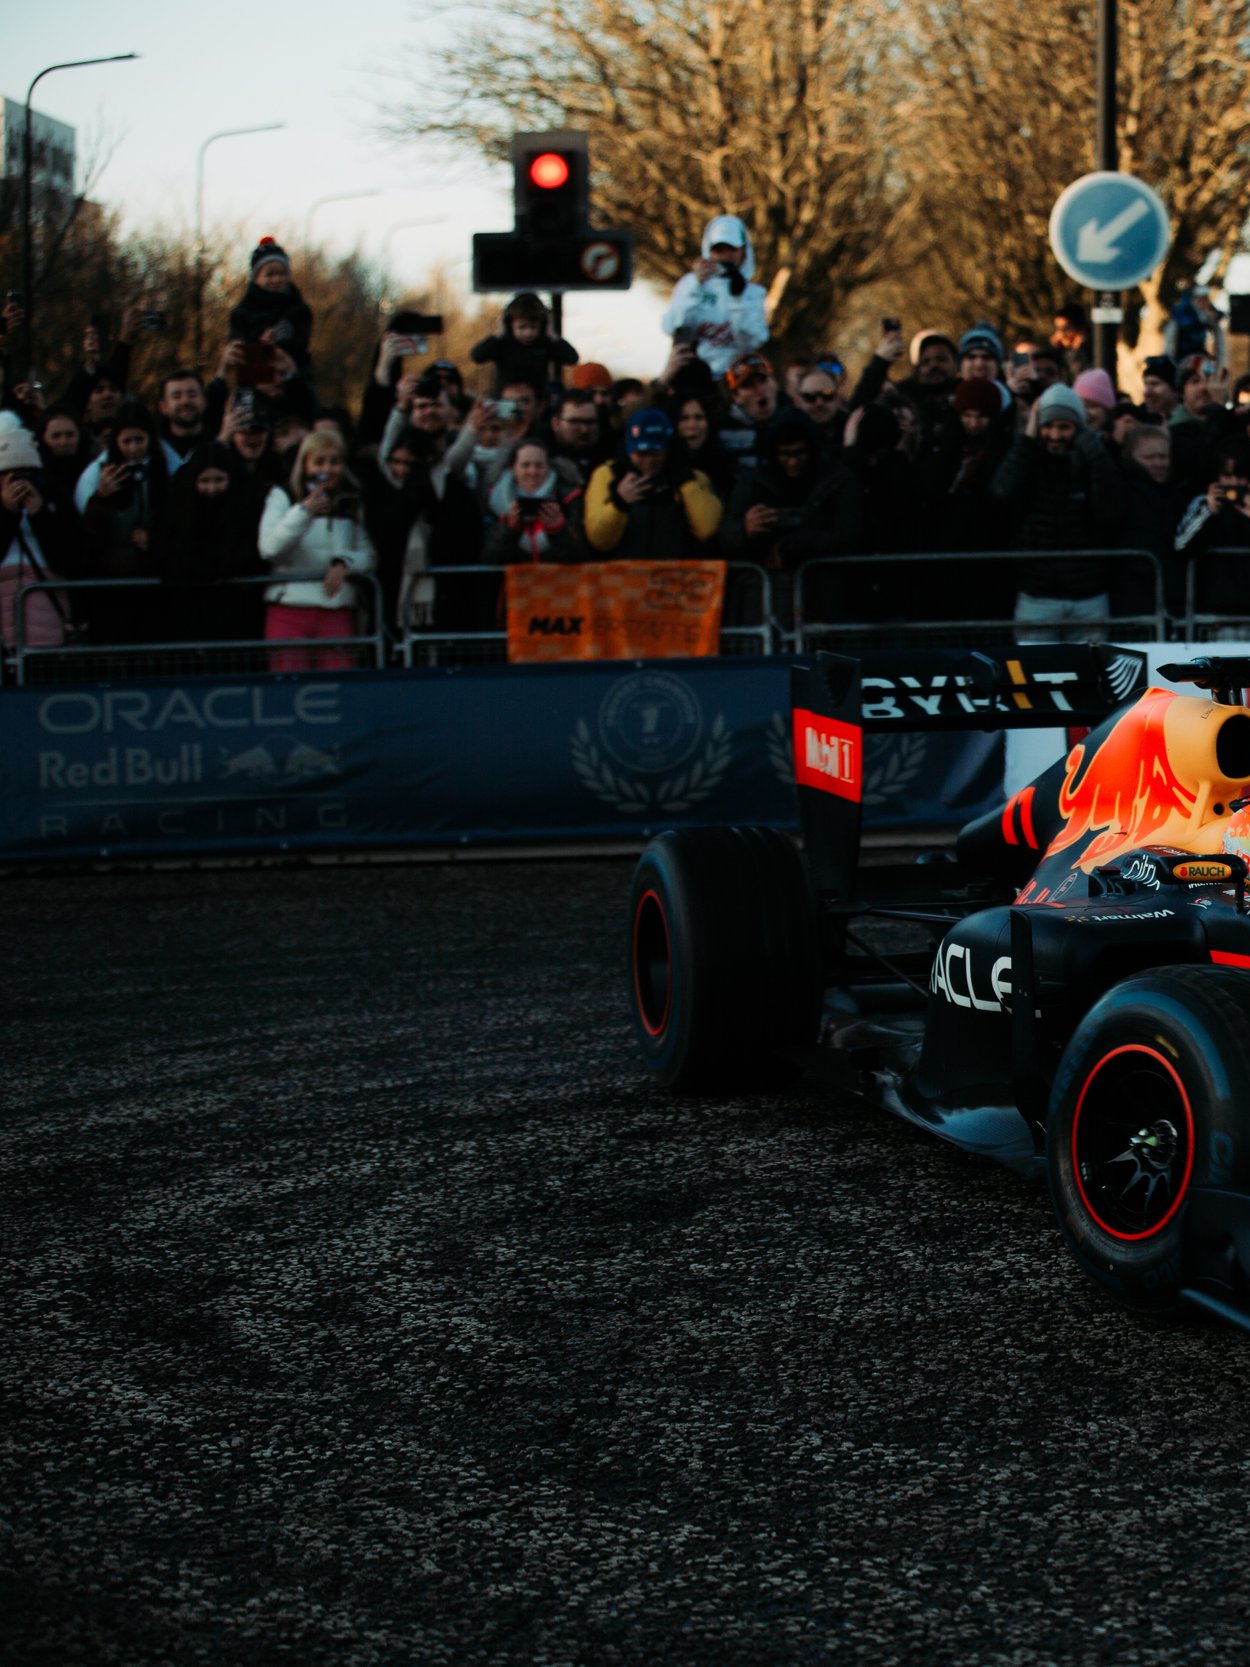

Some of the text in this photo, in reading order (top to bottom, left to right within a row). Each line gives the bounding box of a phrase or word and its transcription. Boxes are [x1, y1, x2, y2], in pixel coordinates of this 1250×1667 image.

[529, 616, 584, 635] MAX
[38, 683, 344, 734] ORACLE
[39, 743, 202, 789] Red Bull
[39, 803, 350, 839] RACING
[1189, 866, 1225, 877] RAUCH
[929, 937, 1013, 1014] ACLE
